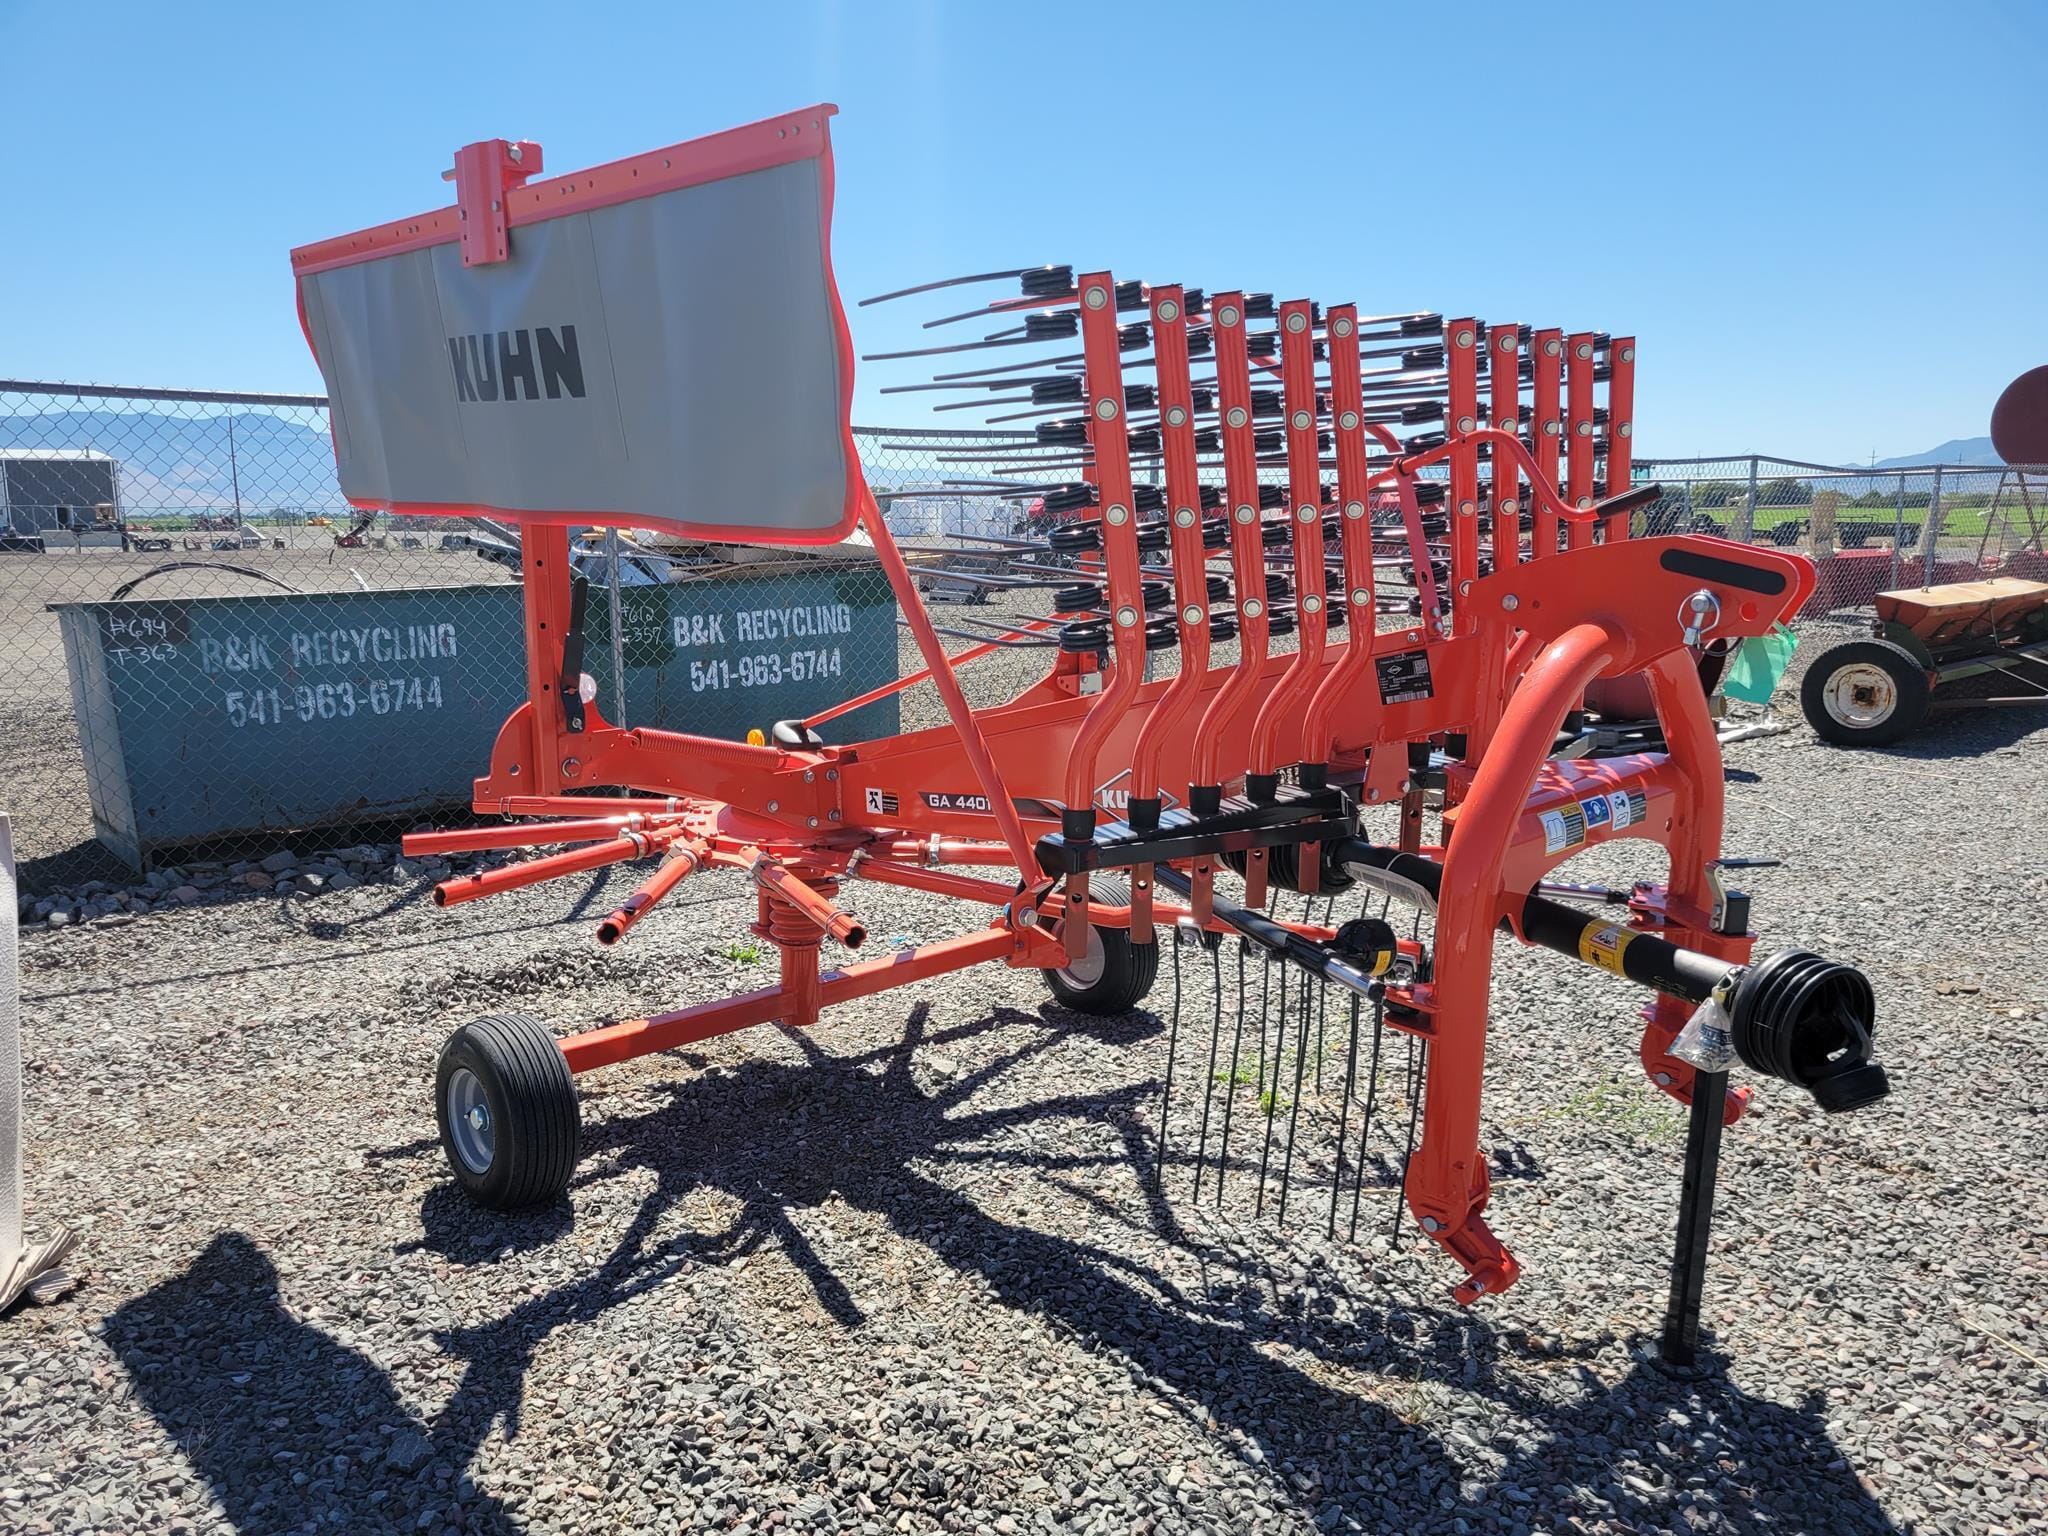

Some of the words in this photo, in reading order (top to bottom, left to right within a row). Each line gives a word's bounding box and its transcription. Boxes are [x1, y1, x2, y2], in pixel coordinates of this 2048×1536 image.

[448, 324, 586, 402] KUHN
[200, 635, 274, 673] B&K
[291, 623, 457, 668] RECYCLING
[673, 613, 727, 648] B&K
[736, 603, 852, 643] RECYCLING
[690, 648, 842, 693] 541-963-6744
[226, 676, 442, 728] 541-963-6744
[929, 794, 951, 808] GA
[1101, 789, 1130, 809] KU
